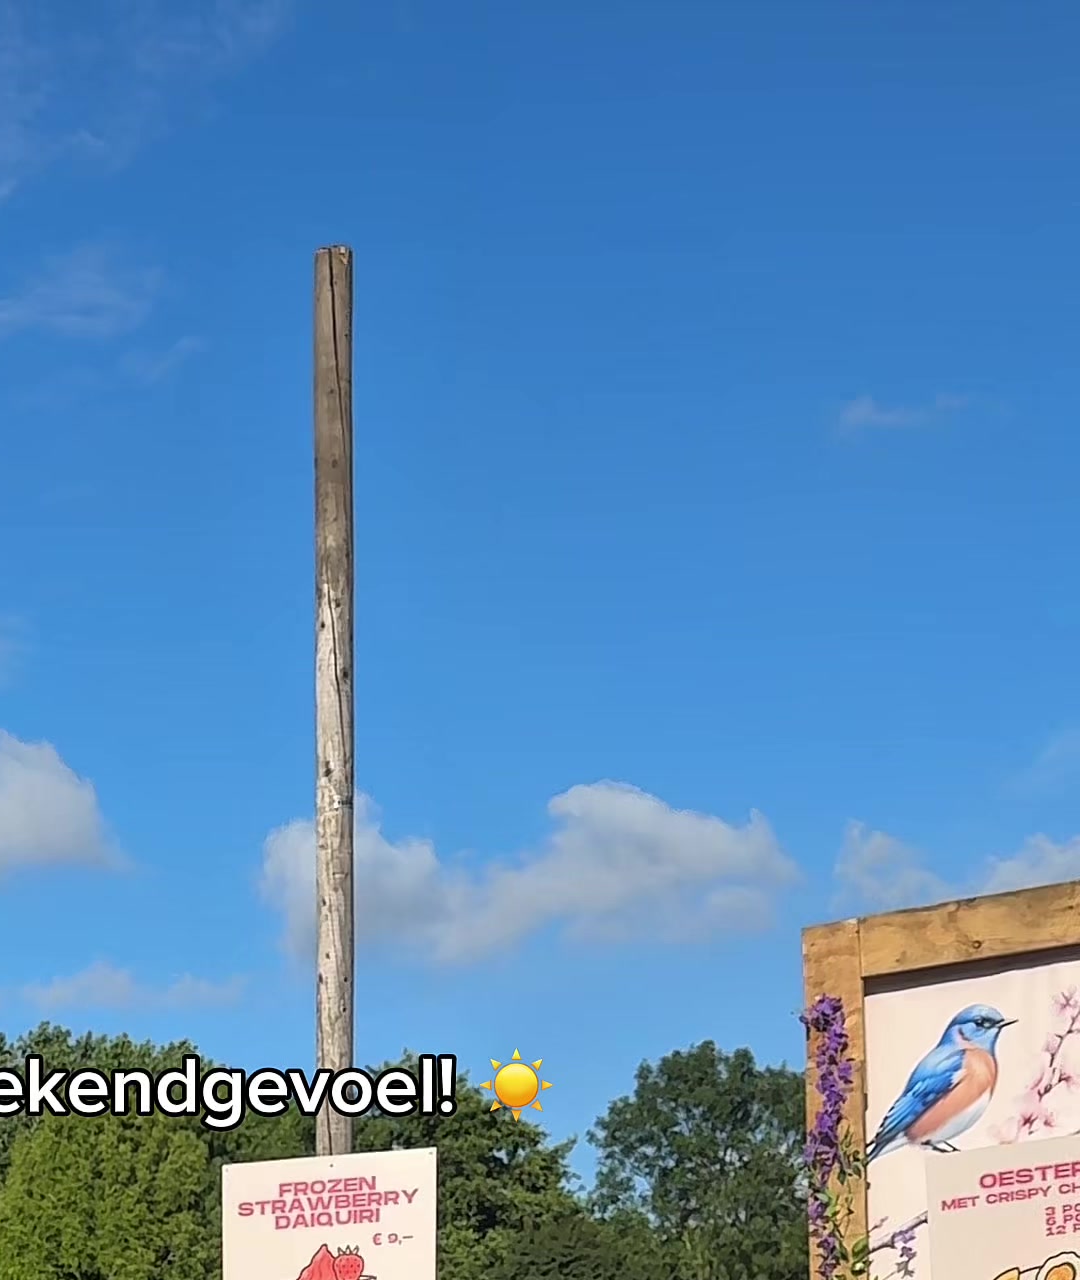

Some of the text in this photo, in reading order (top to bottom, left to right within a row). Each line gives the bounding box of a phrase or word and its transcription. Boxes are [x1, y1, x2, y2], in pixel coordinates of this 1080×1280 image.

[279, 1176, 377, 1197] FROZEN
[237, 1188, 419, 1217] STRAWBERRY
[941, 1195, 980, 1211] MET
[985, 1185, 1052, 1204] CRISPY
[275, 1208, 381, 1230] DAIQUIRI
[1045, 1206, 1056, 1216] 3
[1046, 1225, 1067, 1237] 12
